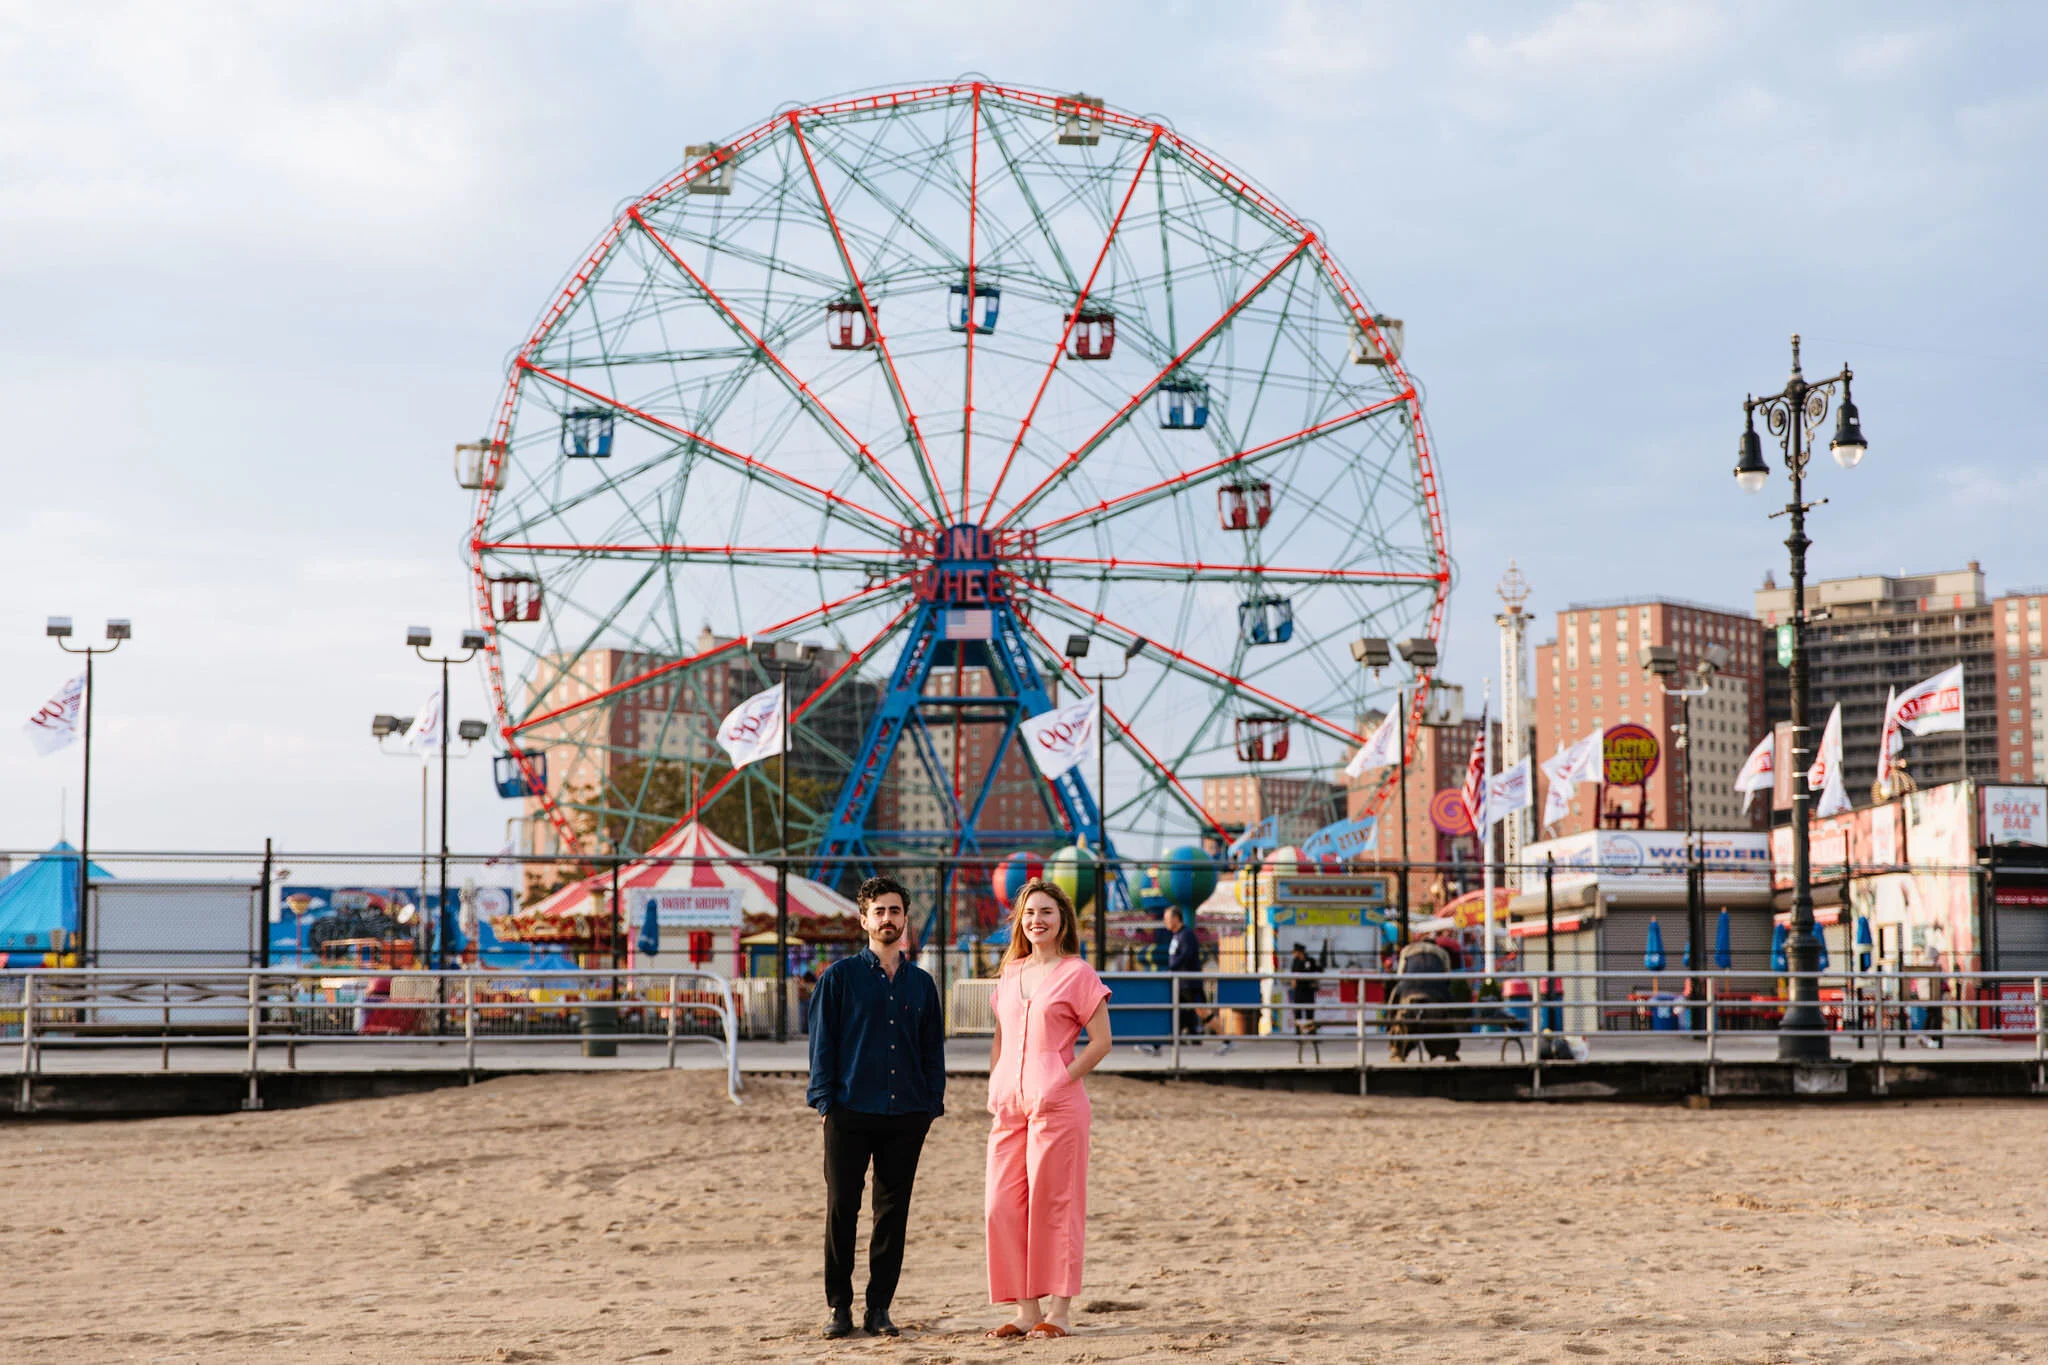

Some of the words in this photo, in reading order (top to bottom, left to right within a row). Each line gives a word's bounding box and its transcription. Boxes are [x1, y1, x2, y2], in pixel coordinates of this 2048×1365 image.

[901, 528, 1037, 560] WONDER
[911, 569, 1029, 603] WHEEL
[1992, 802, 2040, 816] SNACK
[2003, 817, 2032, 830] BAR
